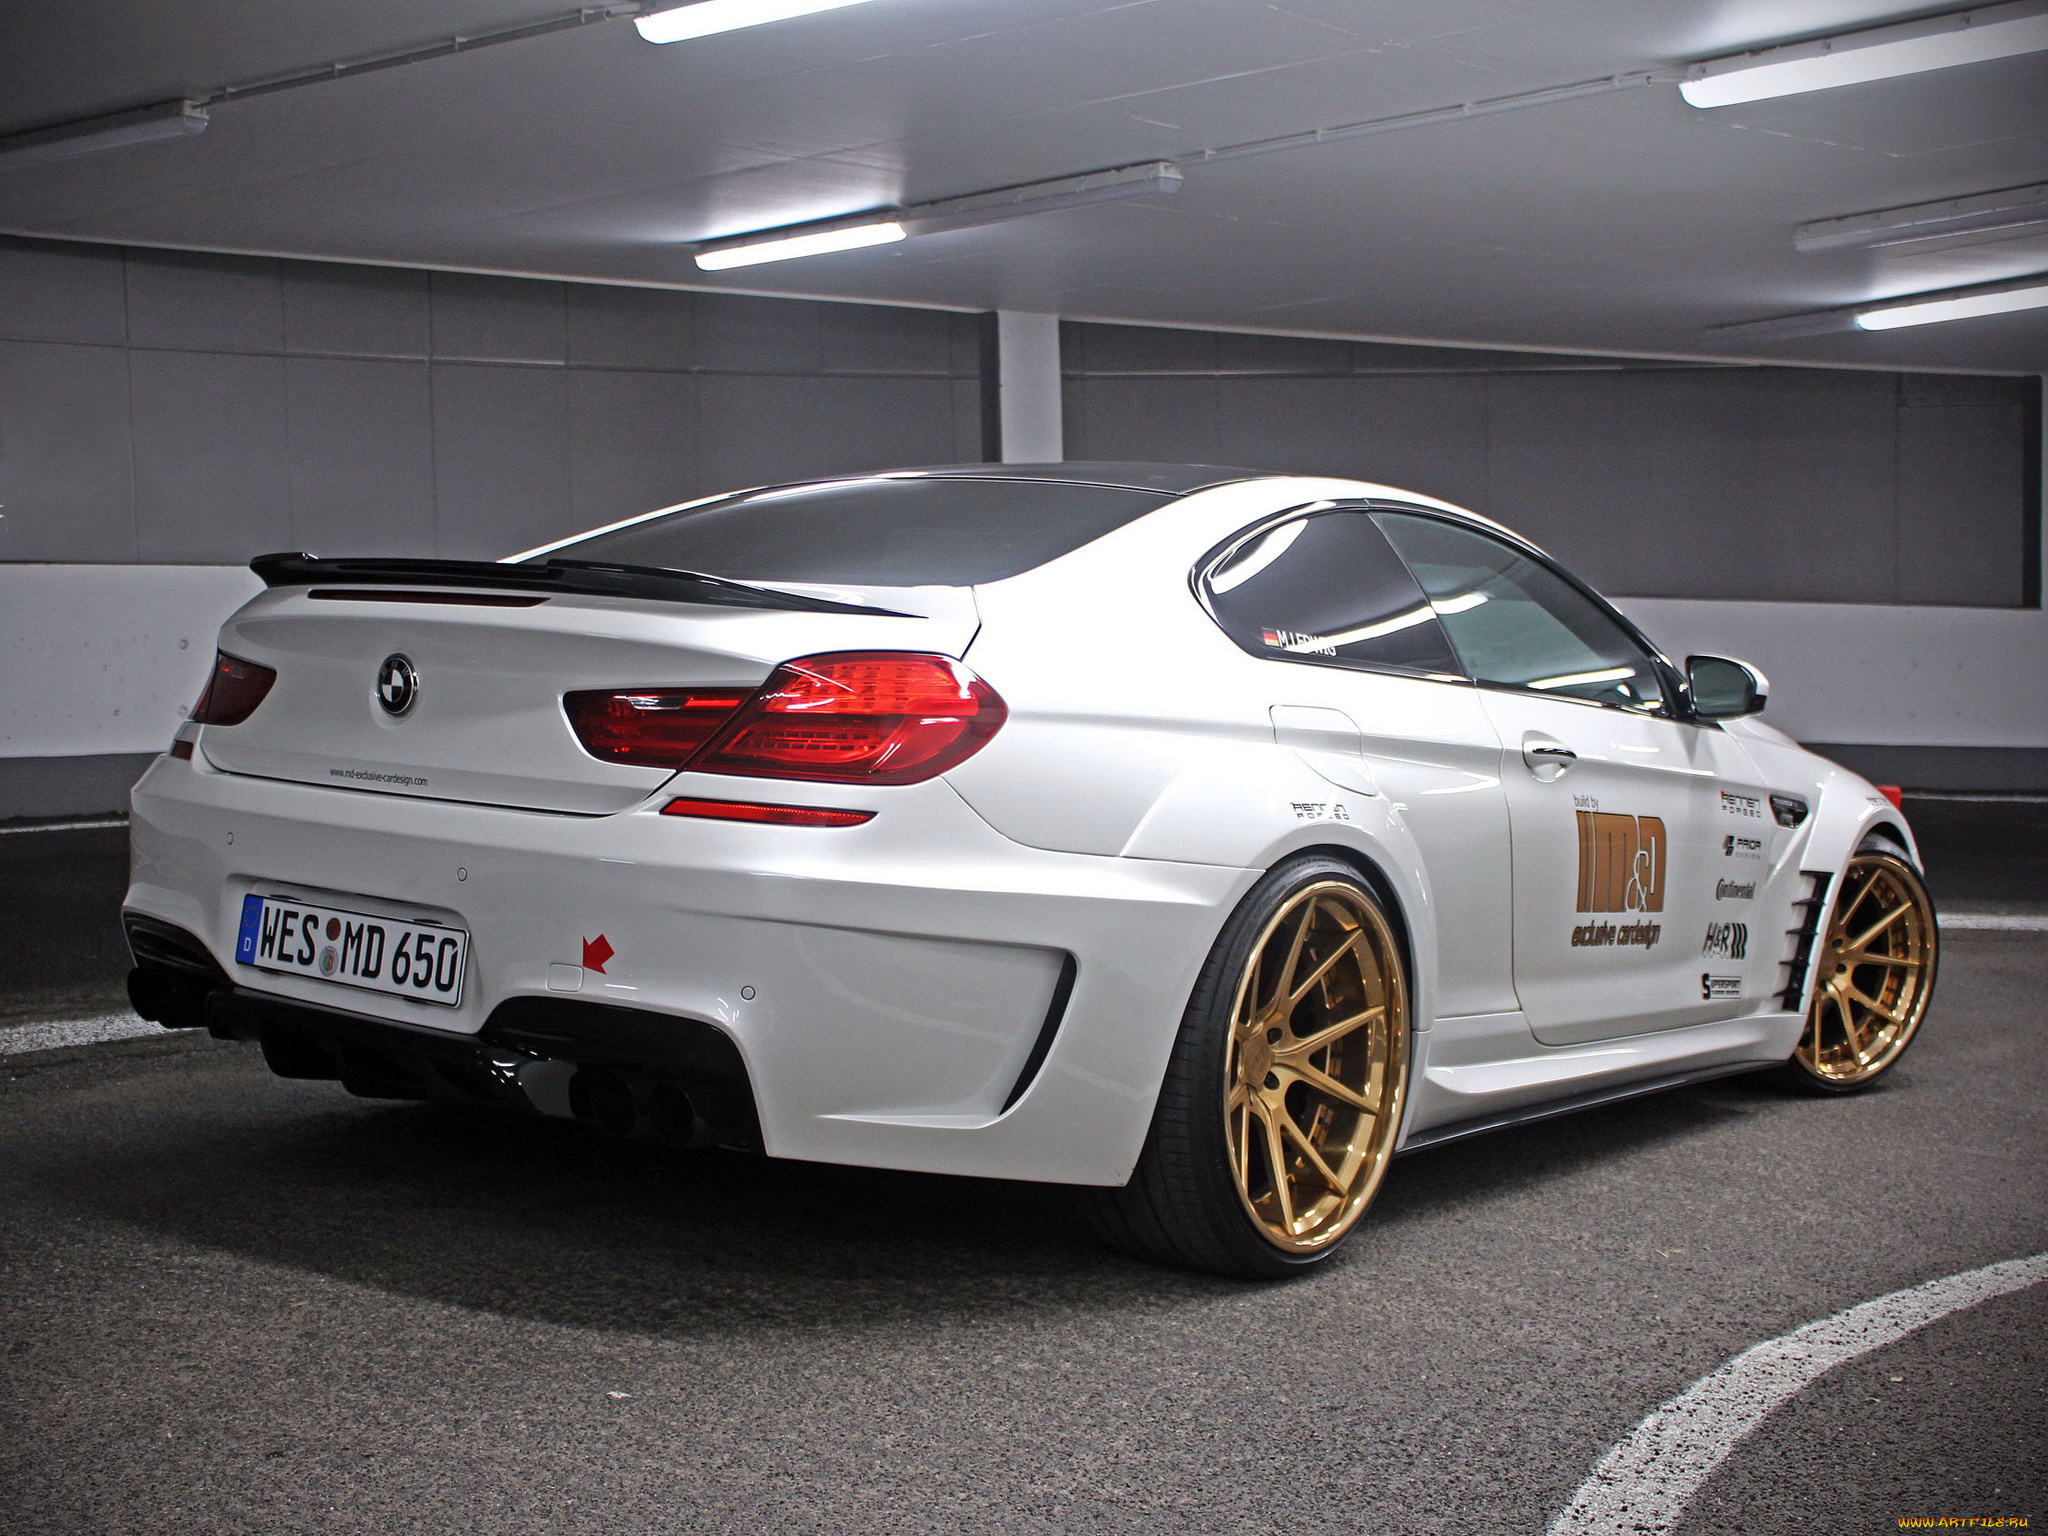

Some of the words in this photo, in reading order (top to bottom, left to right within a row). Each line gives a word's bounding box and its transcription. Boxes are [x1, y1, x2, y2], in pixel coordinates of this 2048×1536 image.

[330, 769, 428, 786] www.md-exclusive-cardesign.com
[1573, 794, 1590, 808] build
[1590, 796, 1599, 812] by
[1716, 878, 1756, 901] Continental
[243, 937, 252, 952] D
[1571, 919, 1617, 947] exclusive
[1617, 919, 1661, 950] cardesign
[260, 906, 319, 965] WES
[340, 921, 385, 979] MD
[391, 932, 459, 992] 650
